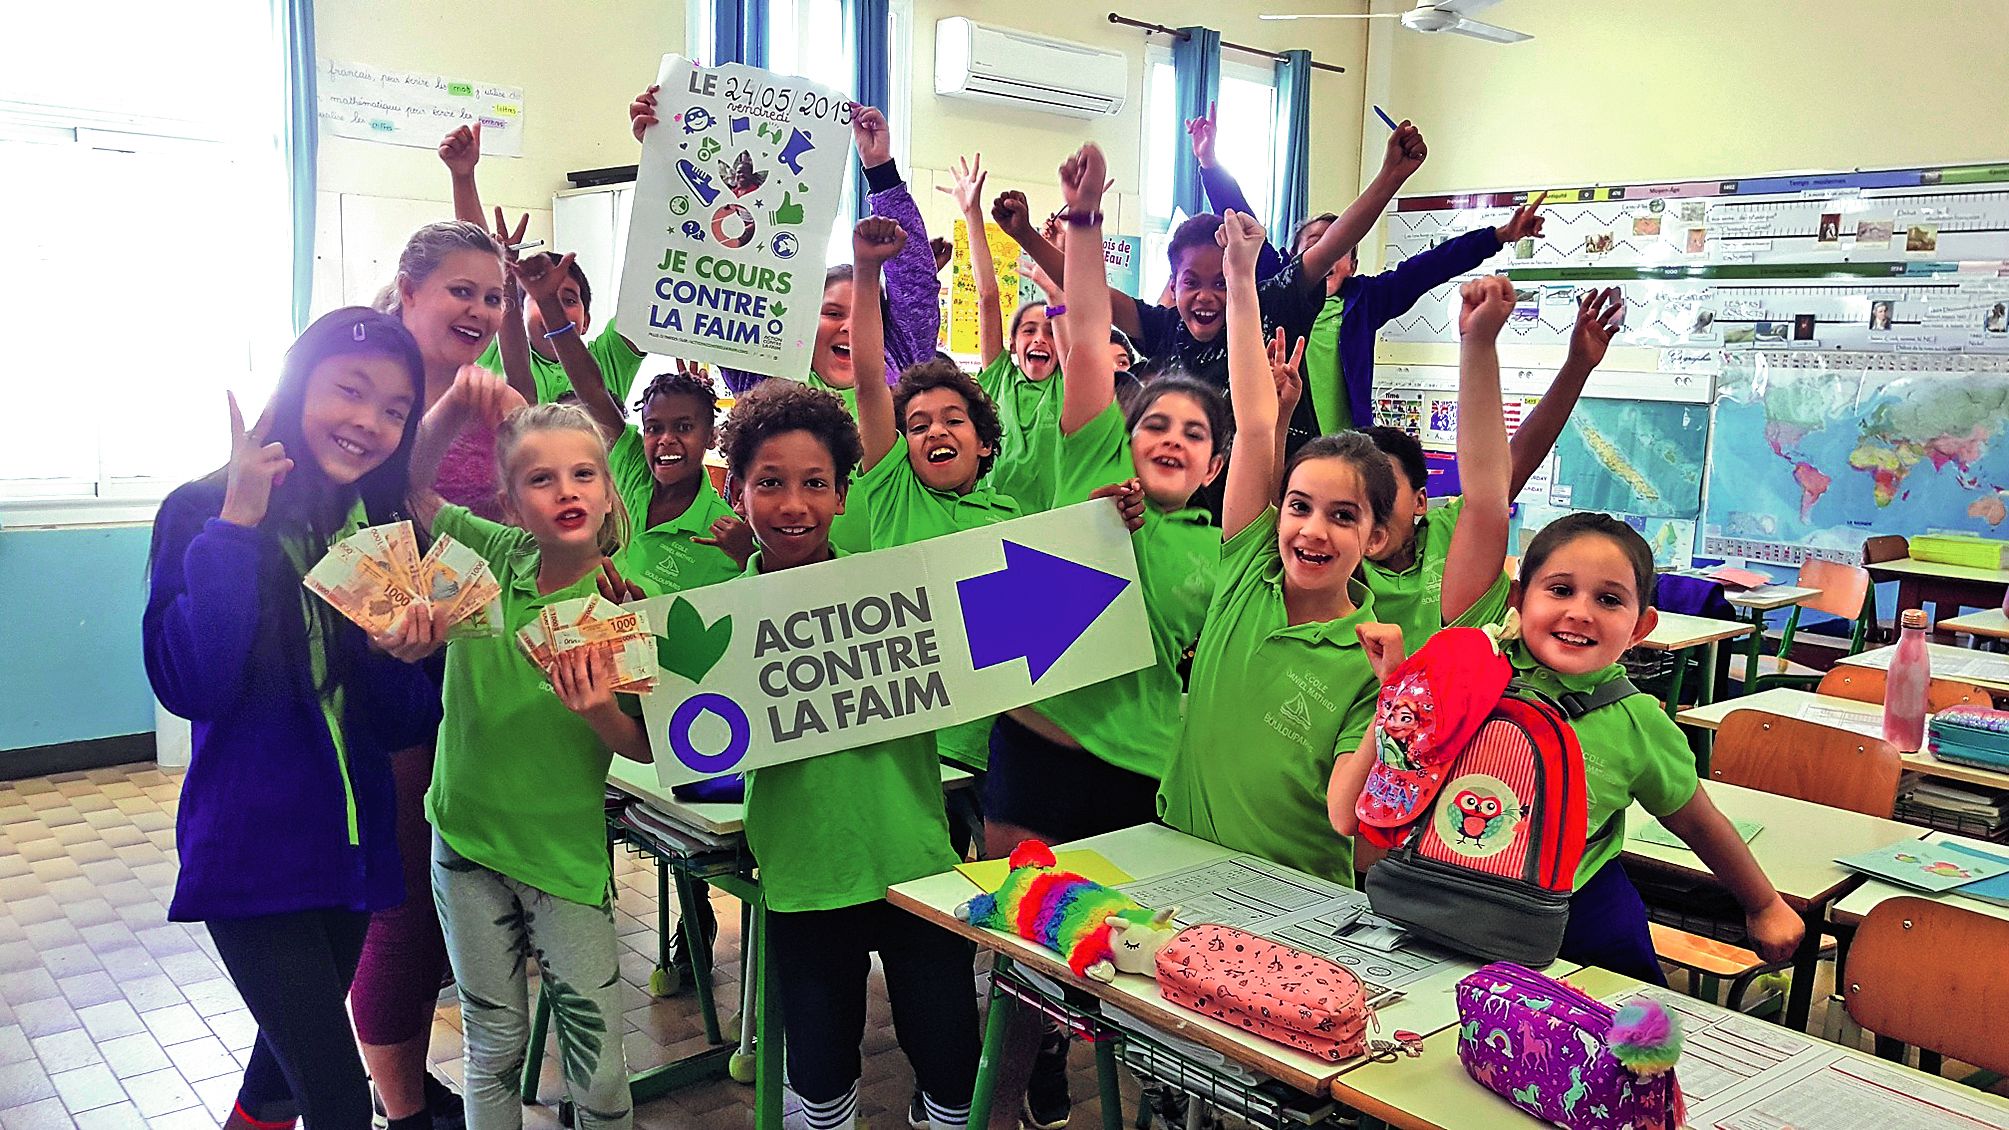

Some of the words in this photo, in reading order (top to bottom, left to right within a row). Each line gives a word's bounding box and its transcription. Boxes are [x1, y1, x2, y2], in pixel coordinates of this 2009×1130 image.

[689, 70, 718, 97] LE
[726, 101, 791, 124] vendredi
[1103, 238, 1116, 251] ois
[1118, 240, 1131, 253] de
[1105, 251, 1122, 265] Eau
[657, 248, 688, 274] JE
[695, 255, 793, 295] COURS
[655, 277, 768, 319] CONTRE
[649, 304, 683, 332] LA
[692, 312, 760, 345] FAIM
[471, 560, 486, 578] 1000
[384, 583, 411, 607] 1000
[610, 616, 637, 632] 1000
[753, 586, 933, 660] ACTION
[758, 630, 941, 698] CONTRE
[766, 701, 828, 744] LA
[831, 671, 951, 729] FAIM
[1583, 751, 1605, 768] COLE
[1367, 773, 1418, 815] OZEN
